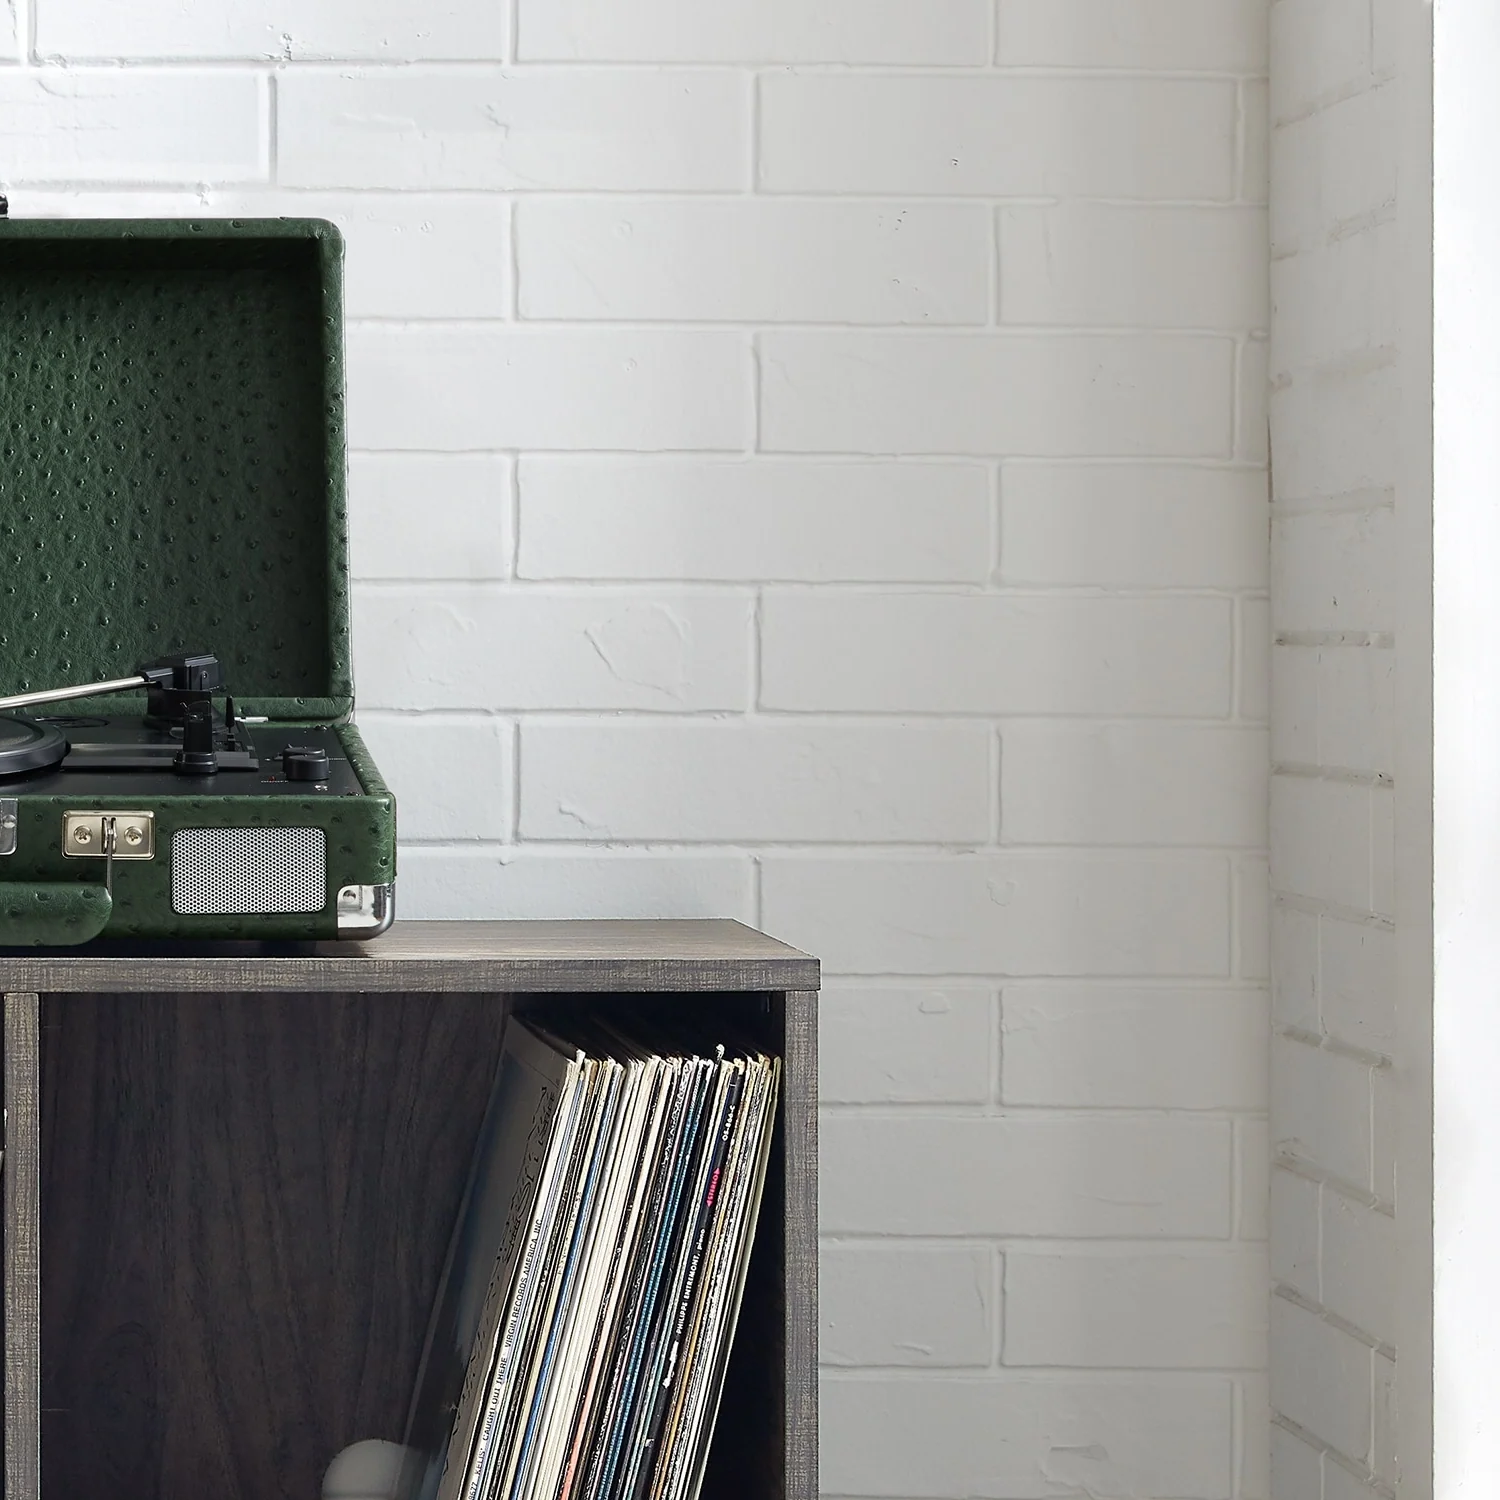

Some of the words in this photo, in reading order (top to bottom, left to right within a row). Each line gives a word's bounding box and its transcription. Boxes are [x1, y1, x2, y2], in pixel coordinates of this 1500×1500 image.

[675, 1301, 689, 1335] PHILIPPE
[683, 1251, 701, 1300] ENTREMONT,
[696, 1228, 706, 1251] piano
[721, 1104, 737, 1142] OS-866-C
[497, 1356, 508, 1385] THERE
[504, 1319, 516, 1348] VIRGIN
[512, 1277, 528, 1319] RECORDS
